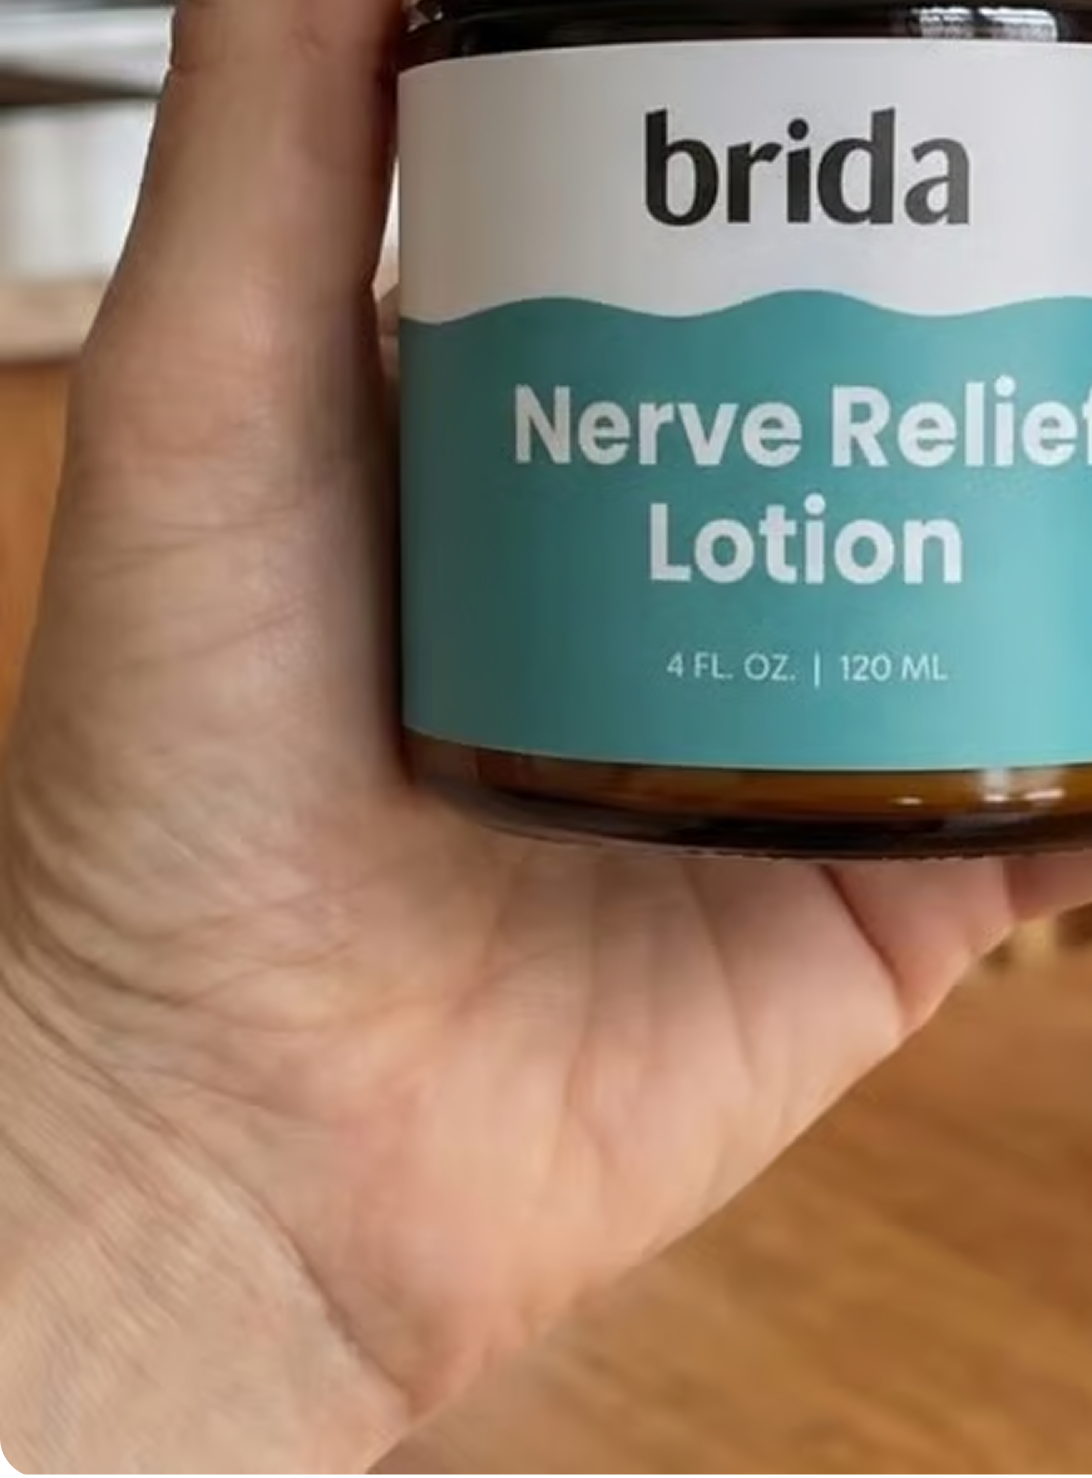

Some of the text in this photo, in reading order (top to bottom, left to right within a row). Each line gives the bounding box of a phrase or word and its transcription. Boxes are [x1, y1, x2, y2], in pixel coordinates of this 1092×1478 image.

[645, 107, 970, 225] brida
[514, 385, 801, 465] Nerve
[650, 493, 962, 583] Lotion
[667, 652, 684, 678] 4
[694, 652, 733, 680] FL.
[743, 652, 796, 681] OZ.
[841, 653, 892, 681] 120
[902, 653, 949, 681] ML
